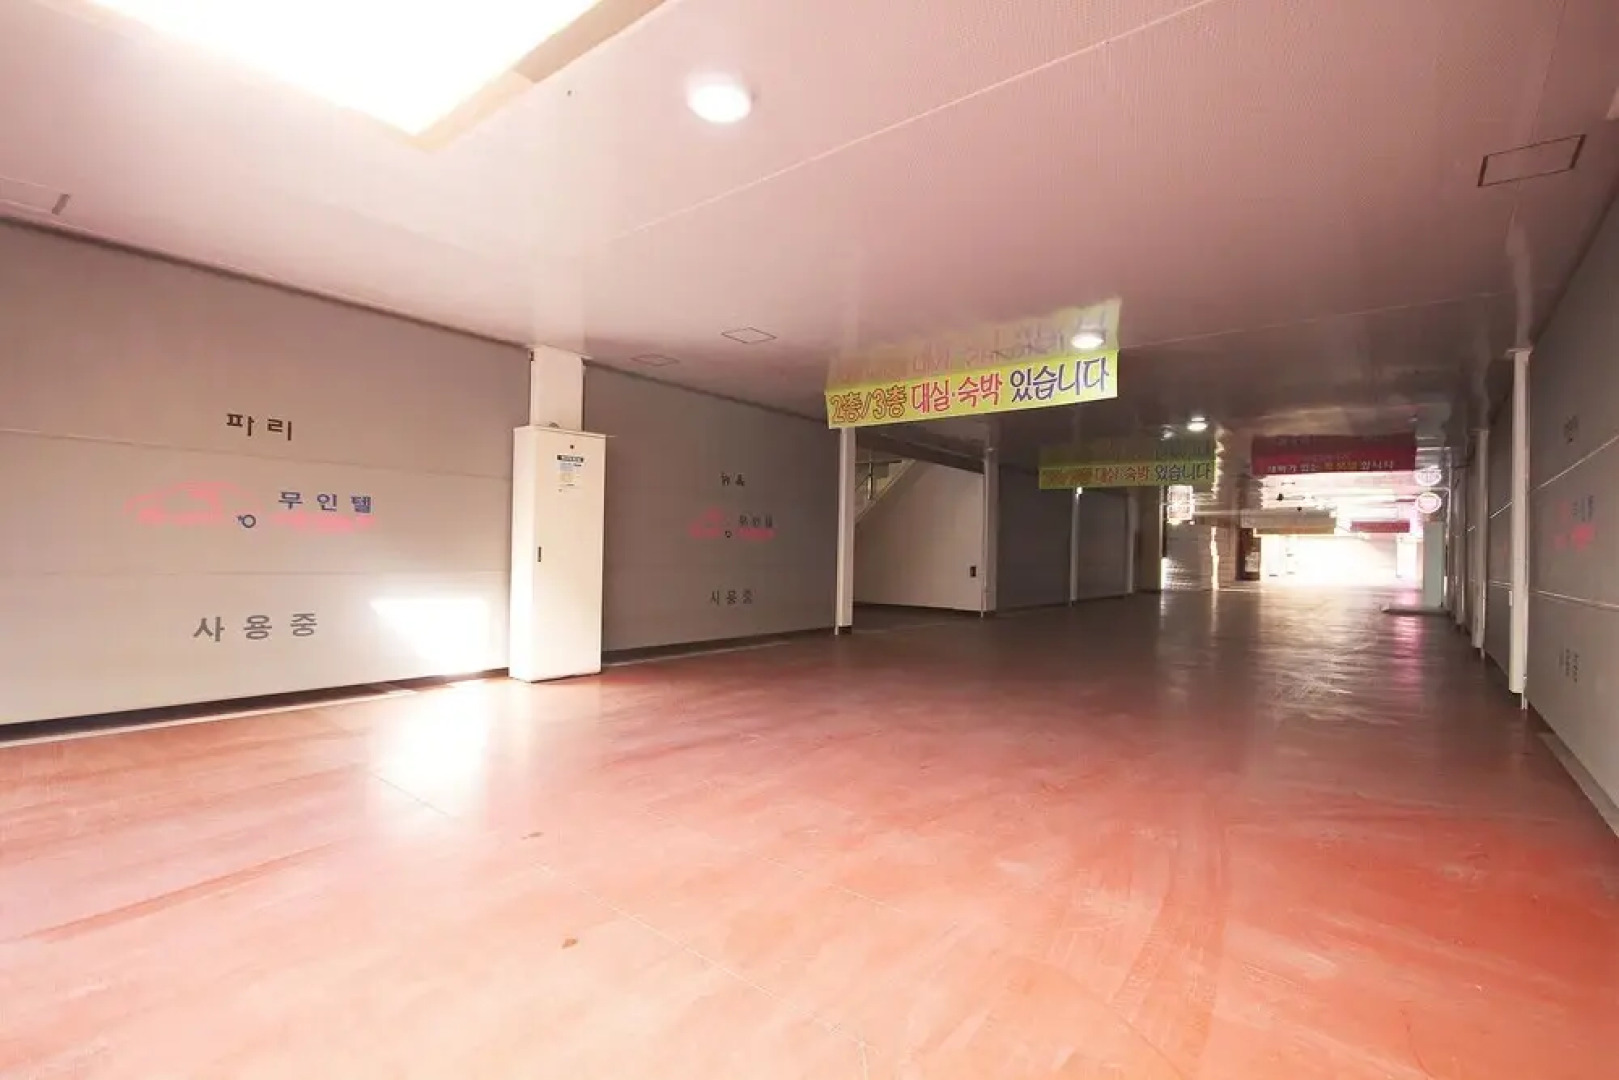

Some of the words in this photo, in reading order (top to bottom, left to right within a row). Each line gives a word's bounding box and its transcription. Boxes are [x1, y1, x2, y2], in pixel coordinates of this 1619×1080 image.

[830, 384, 908, 423] 2층/3층
[911, 372, 1003, 414] 대실·숙박
[1010, 357, 1110, 403] 있습니다
[1155, 462, 1211, 482] 있습니다
[278, 490, 373, 514] 무인텔
[193, 612, 318, 642] 사용중
